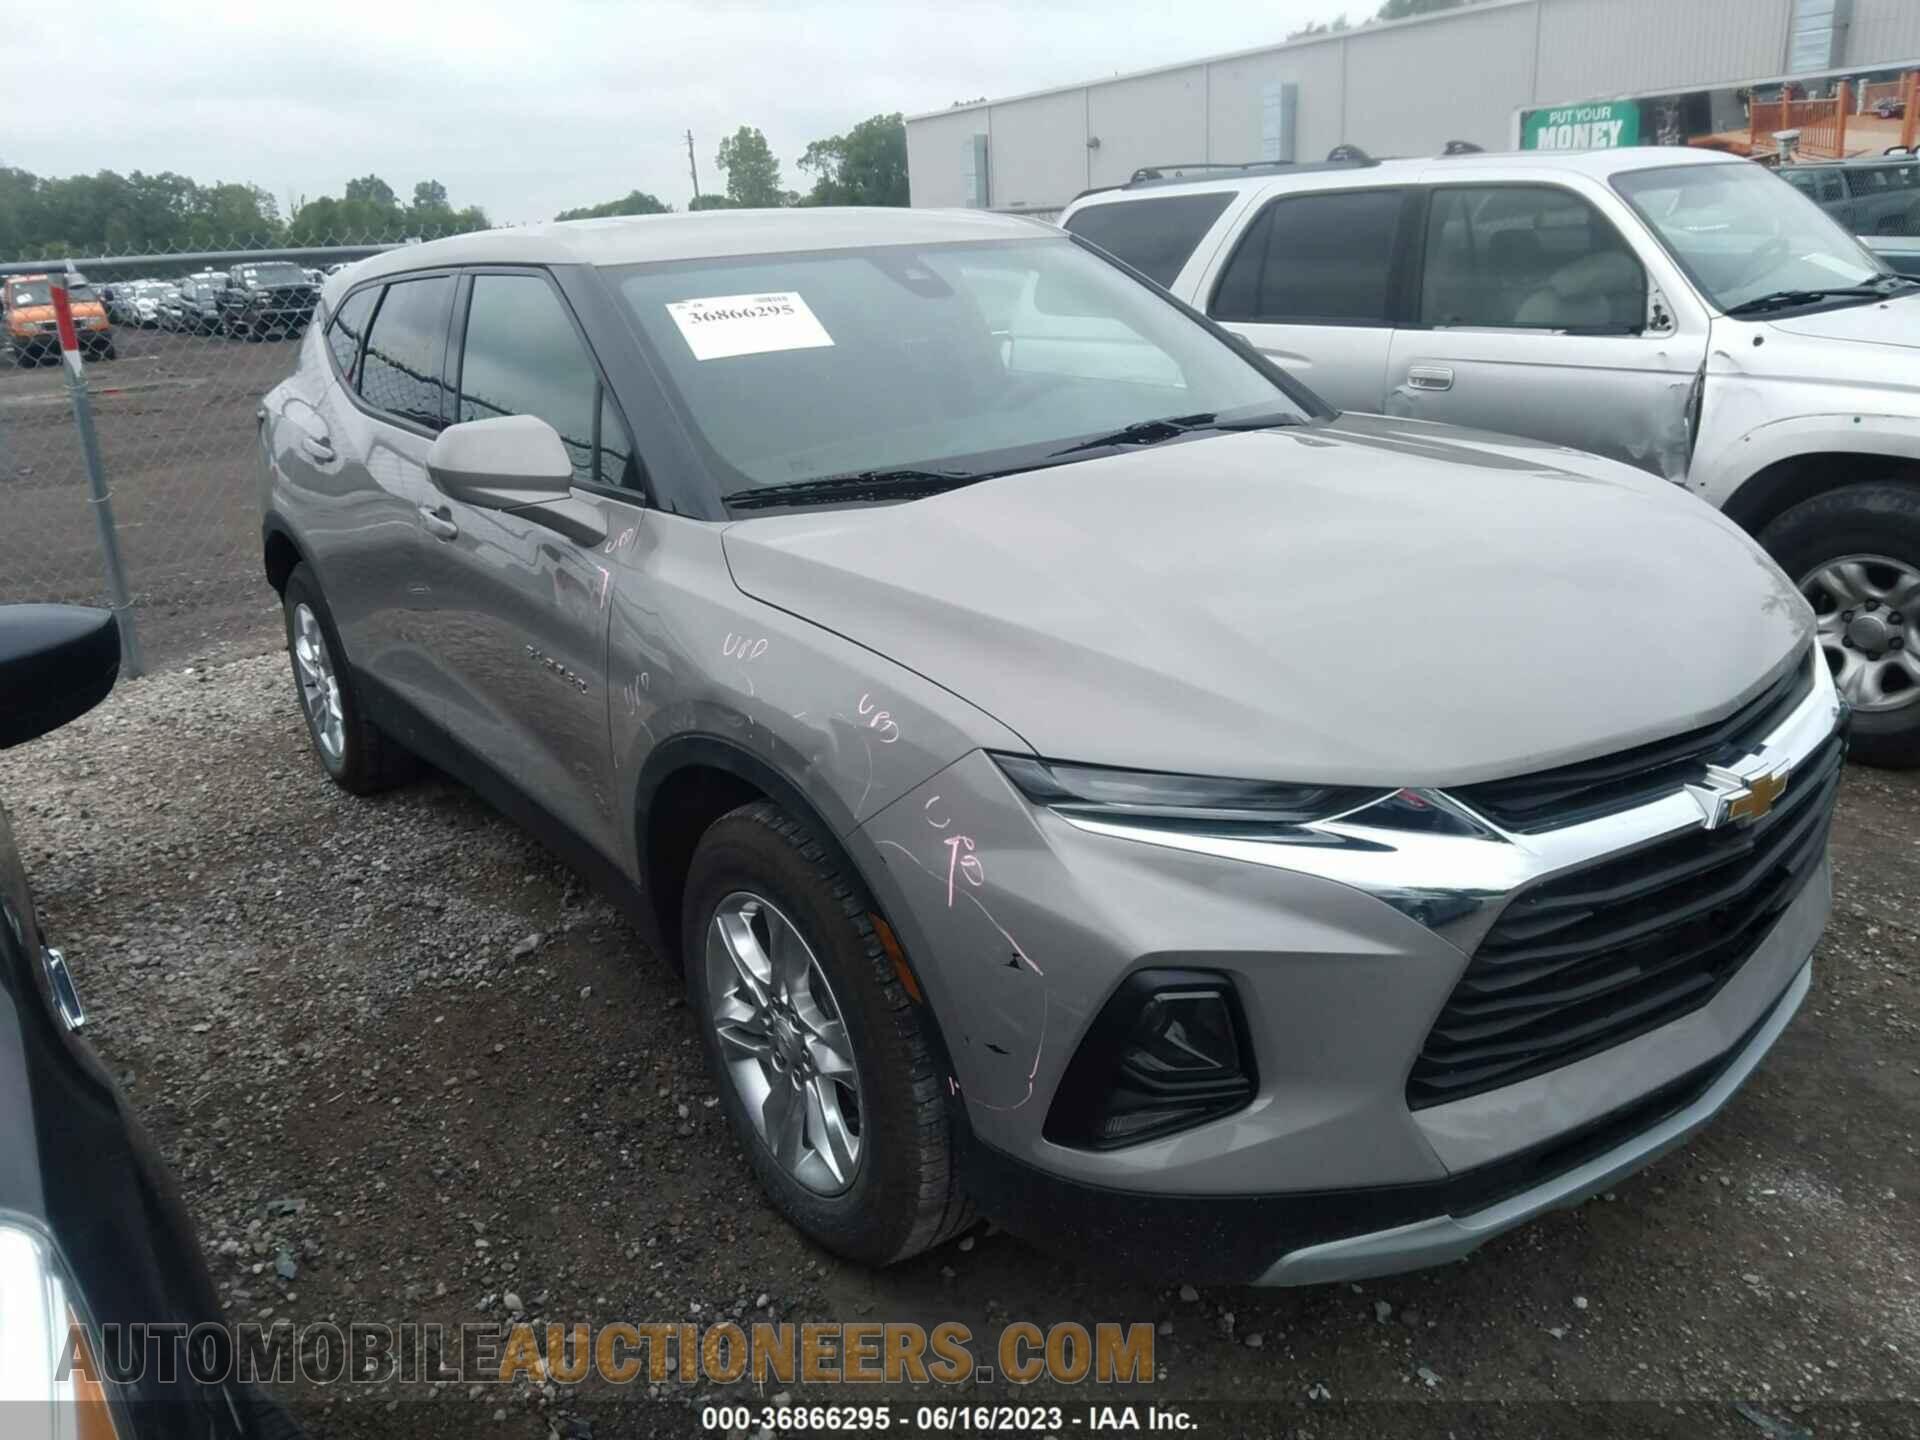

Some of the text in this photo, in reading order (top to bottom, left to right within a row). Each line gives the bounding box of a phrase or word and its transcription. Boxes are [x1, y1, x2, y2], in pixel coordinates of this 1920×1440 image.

[1550, 106, 1612, 124] PUT YOUR
[1537, 119, 1624, 150] MONEY
[688, 304, 795, 324] 36866295
